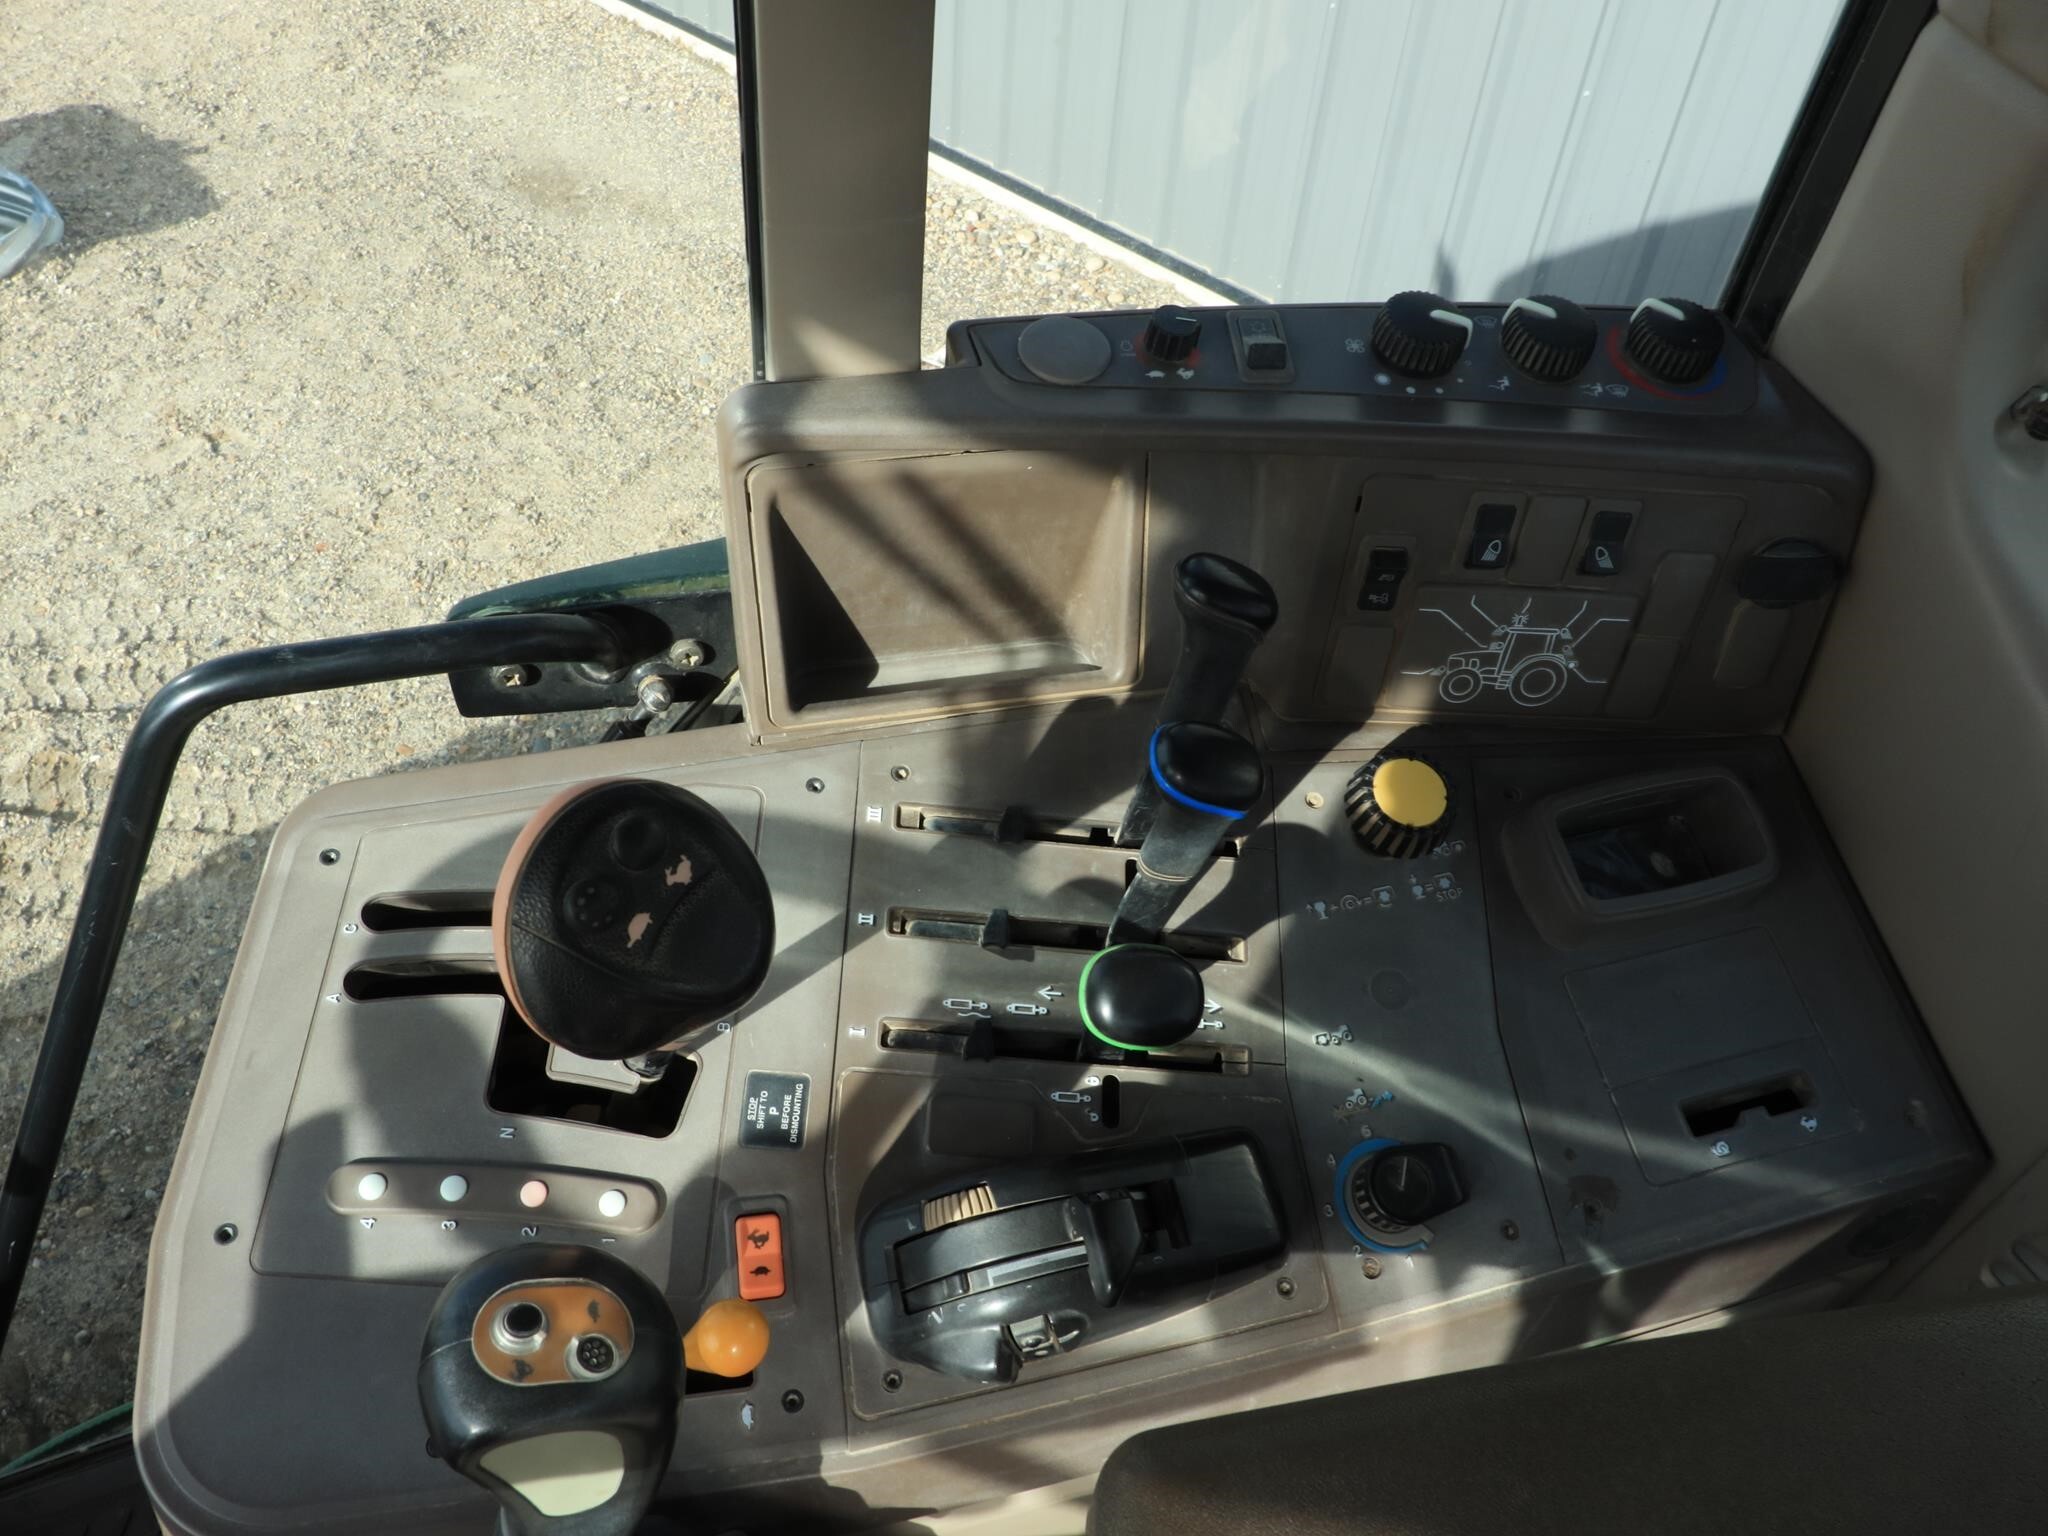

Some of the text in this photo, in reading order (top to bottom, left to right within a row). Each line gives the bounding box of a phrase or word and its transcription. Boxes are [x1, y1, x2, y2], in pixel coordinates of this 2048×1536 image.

[867, 806, 882, 822] III
[858, 913, 873, 925] II
[326, 993, 341, 1003] A
[717, 1022, 731, 1032] B
[747, 1097, 758, 1120] STOP
[756, 1091, 769, 1129] SHIFT TO
[769, 1106, 779, 1116] P
[781, 1095, 792, 1130] BEFORE
[790, 1083, 804, 1143] DISMOUNTING
[500, 1127, 515, 1139] N
[360, 1217, 376, 1229] 4
[441, 1220, 457, 1231] 3
[521, 1225, 537, 1237] 2
